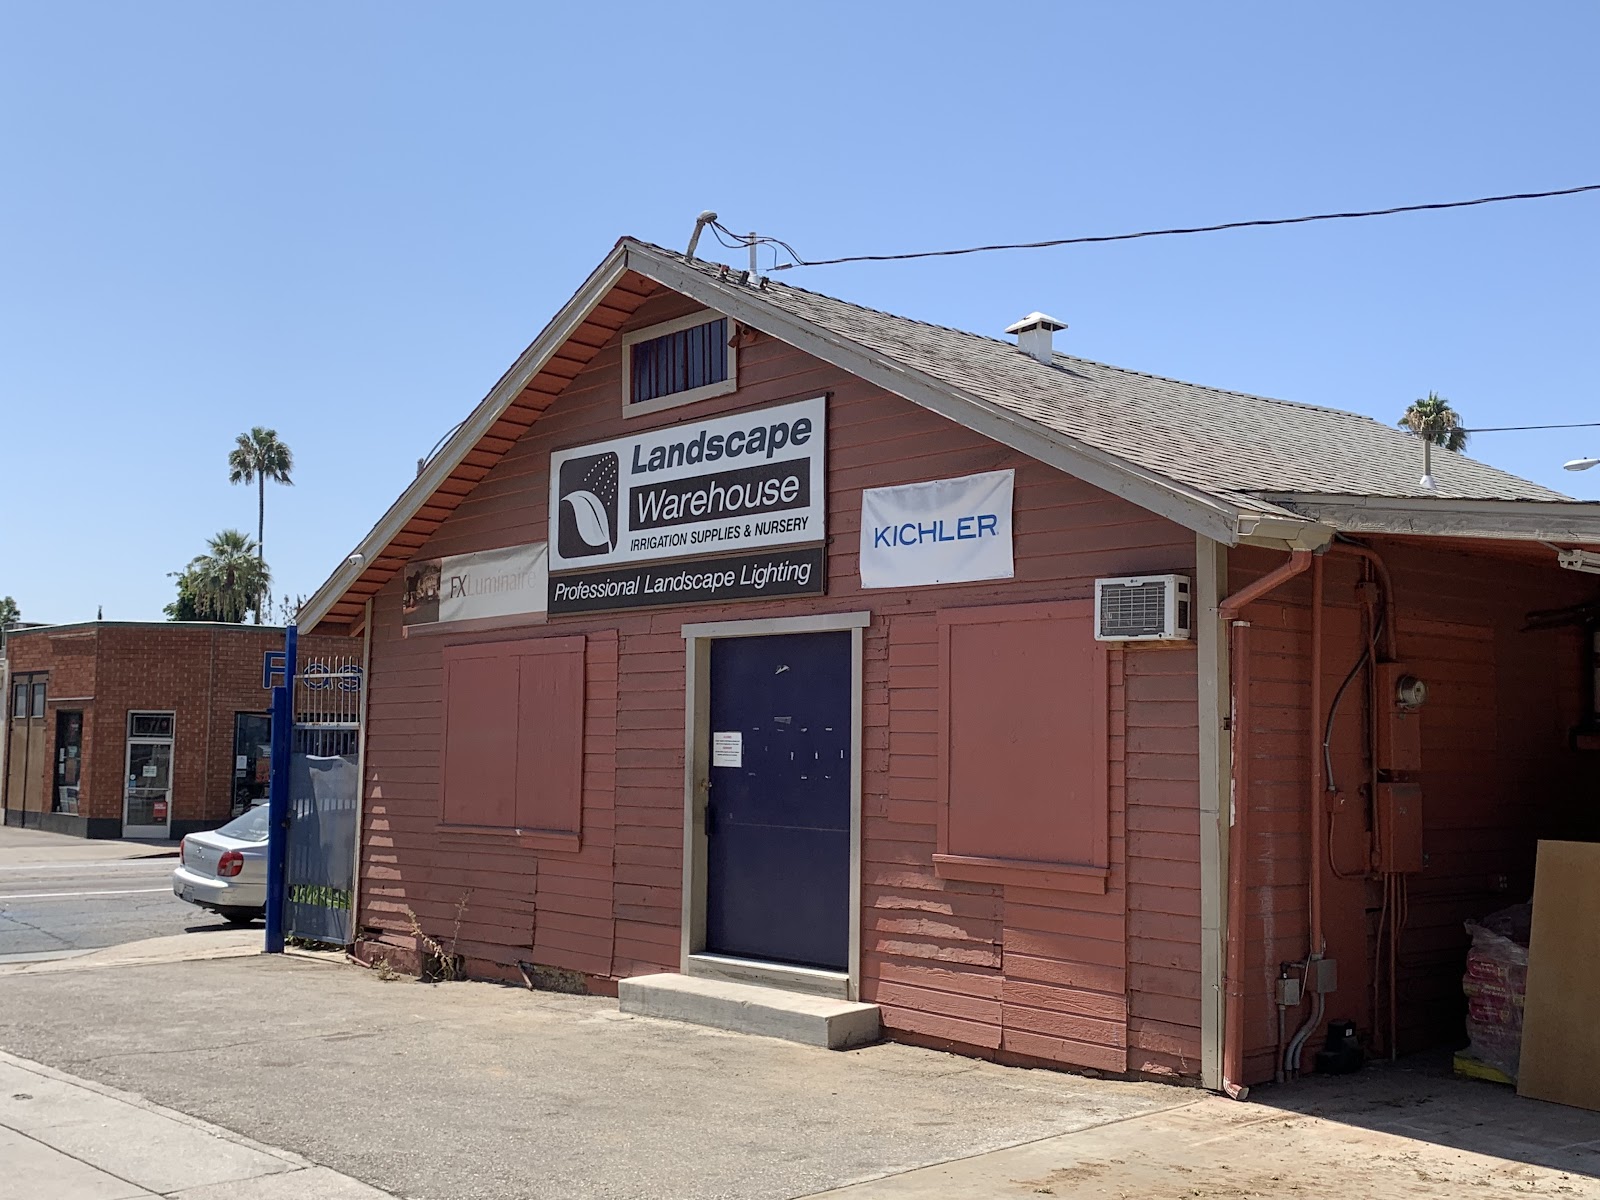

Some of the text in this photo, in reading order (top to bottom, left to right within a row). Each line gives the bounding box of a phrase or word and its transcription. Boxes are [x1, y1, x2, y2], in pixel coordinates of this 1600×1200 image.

[630, 417, 812, 475] Landscape
[637, 474, 800, 524] Warehouse
[630, 516, 809, 552] IRRIGATION SUPPLIES & NURSERY
[874, 514, 998, 549] KICHLER
[554, 560, 812, 601] Professional Landscape Lighting
